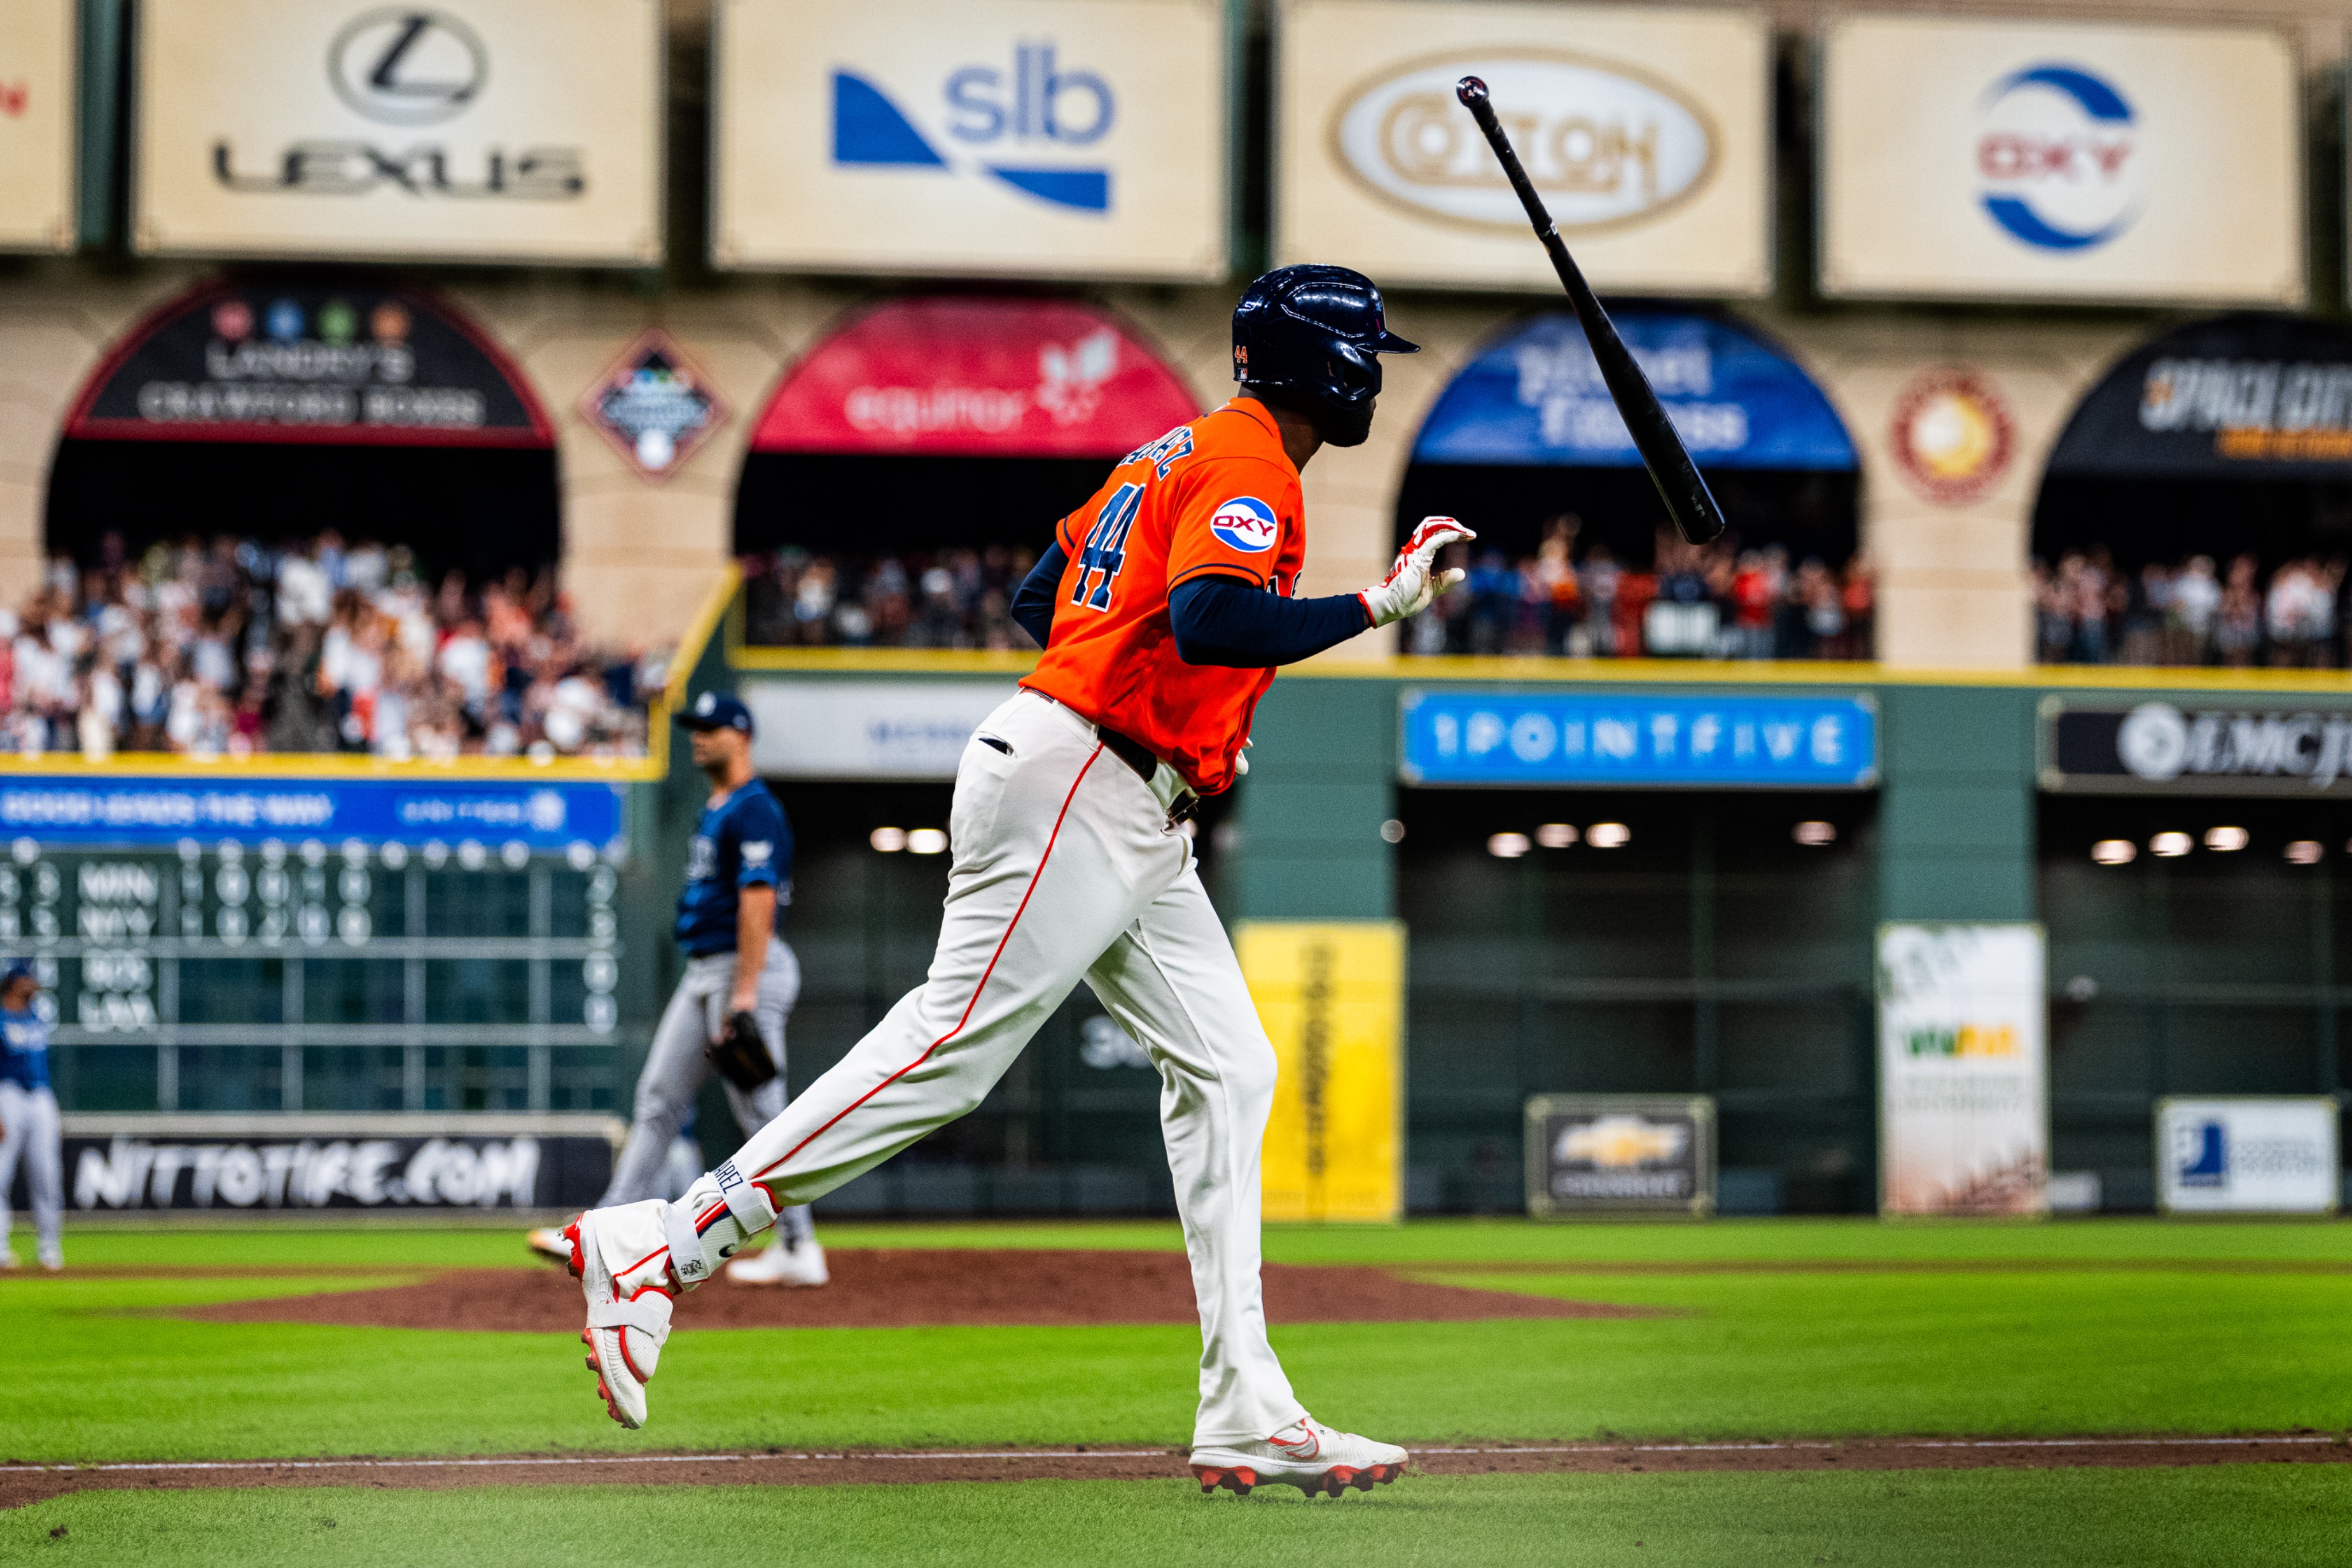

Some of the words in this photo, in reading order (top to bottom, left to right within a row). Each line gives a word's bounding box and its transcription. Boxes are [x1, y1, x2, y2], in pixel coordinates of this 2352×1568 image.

[943, 39, 1116, 146] slb
[210, 138, 587, 199] LEXUS
[1977, 133, 2132, 181] OXY
[1235, 345, 1248, 363] 44
[845, 384, 1029, 435] equinor
[1071, 482, 1147, 613] 44
[1213, 515, 1275, 537] OXY
[1433, 710, 1843, 765] 1POINTFIVE
[2187, 713, 2352, 787] EMCJ
[74, 1135, 541, 1209] NITTOTIRE.COM
[713, 1159, 744, 1194] AREZ
